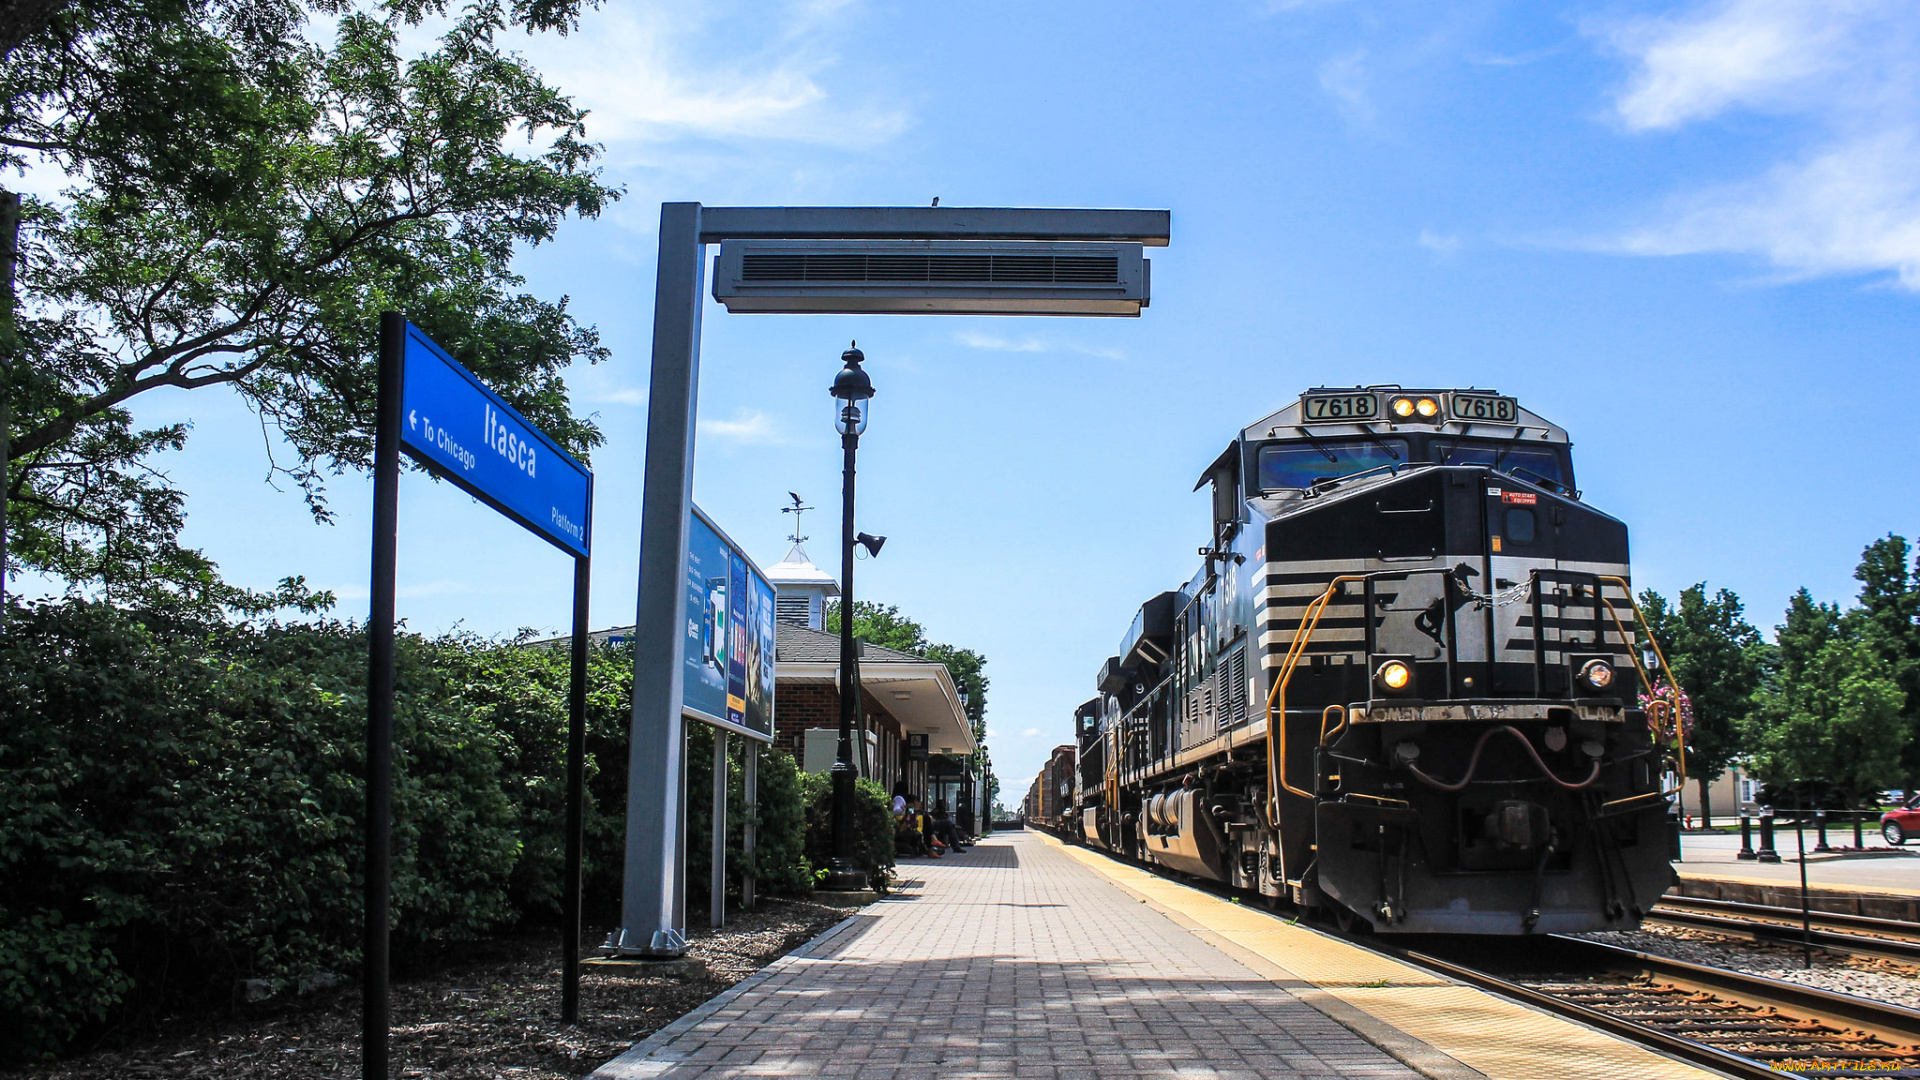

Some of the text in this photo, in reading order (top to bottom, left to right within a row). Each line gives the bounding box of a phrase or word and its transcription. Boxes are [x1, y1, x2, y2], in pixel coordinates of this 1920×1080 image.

[1313, 396, 1370, 417] 7618
[1461, 398, 1509, 420] 7618
[423, 417, 475, 471] To Chicago
[484, 403, 536, 479] Itasca
[551, 506, 584, 542] Platform 2
